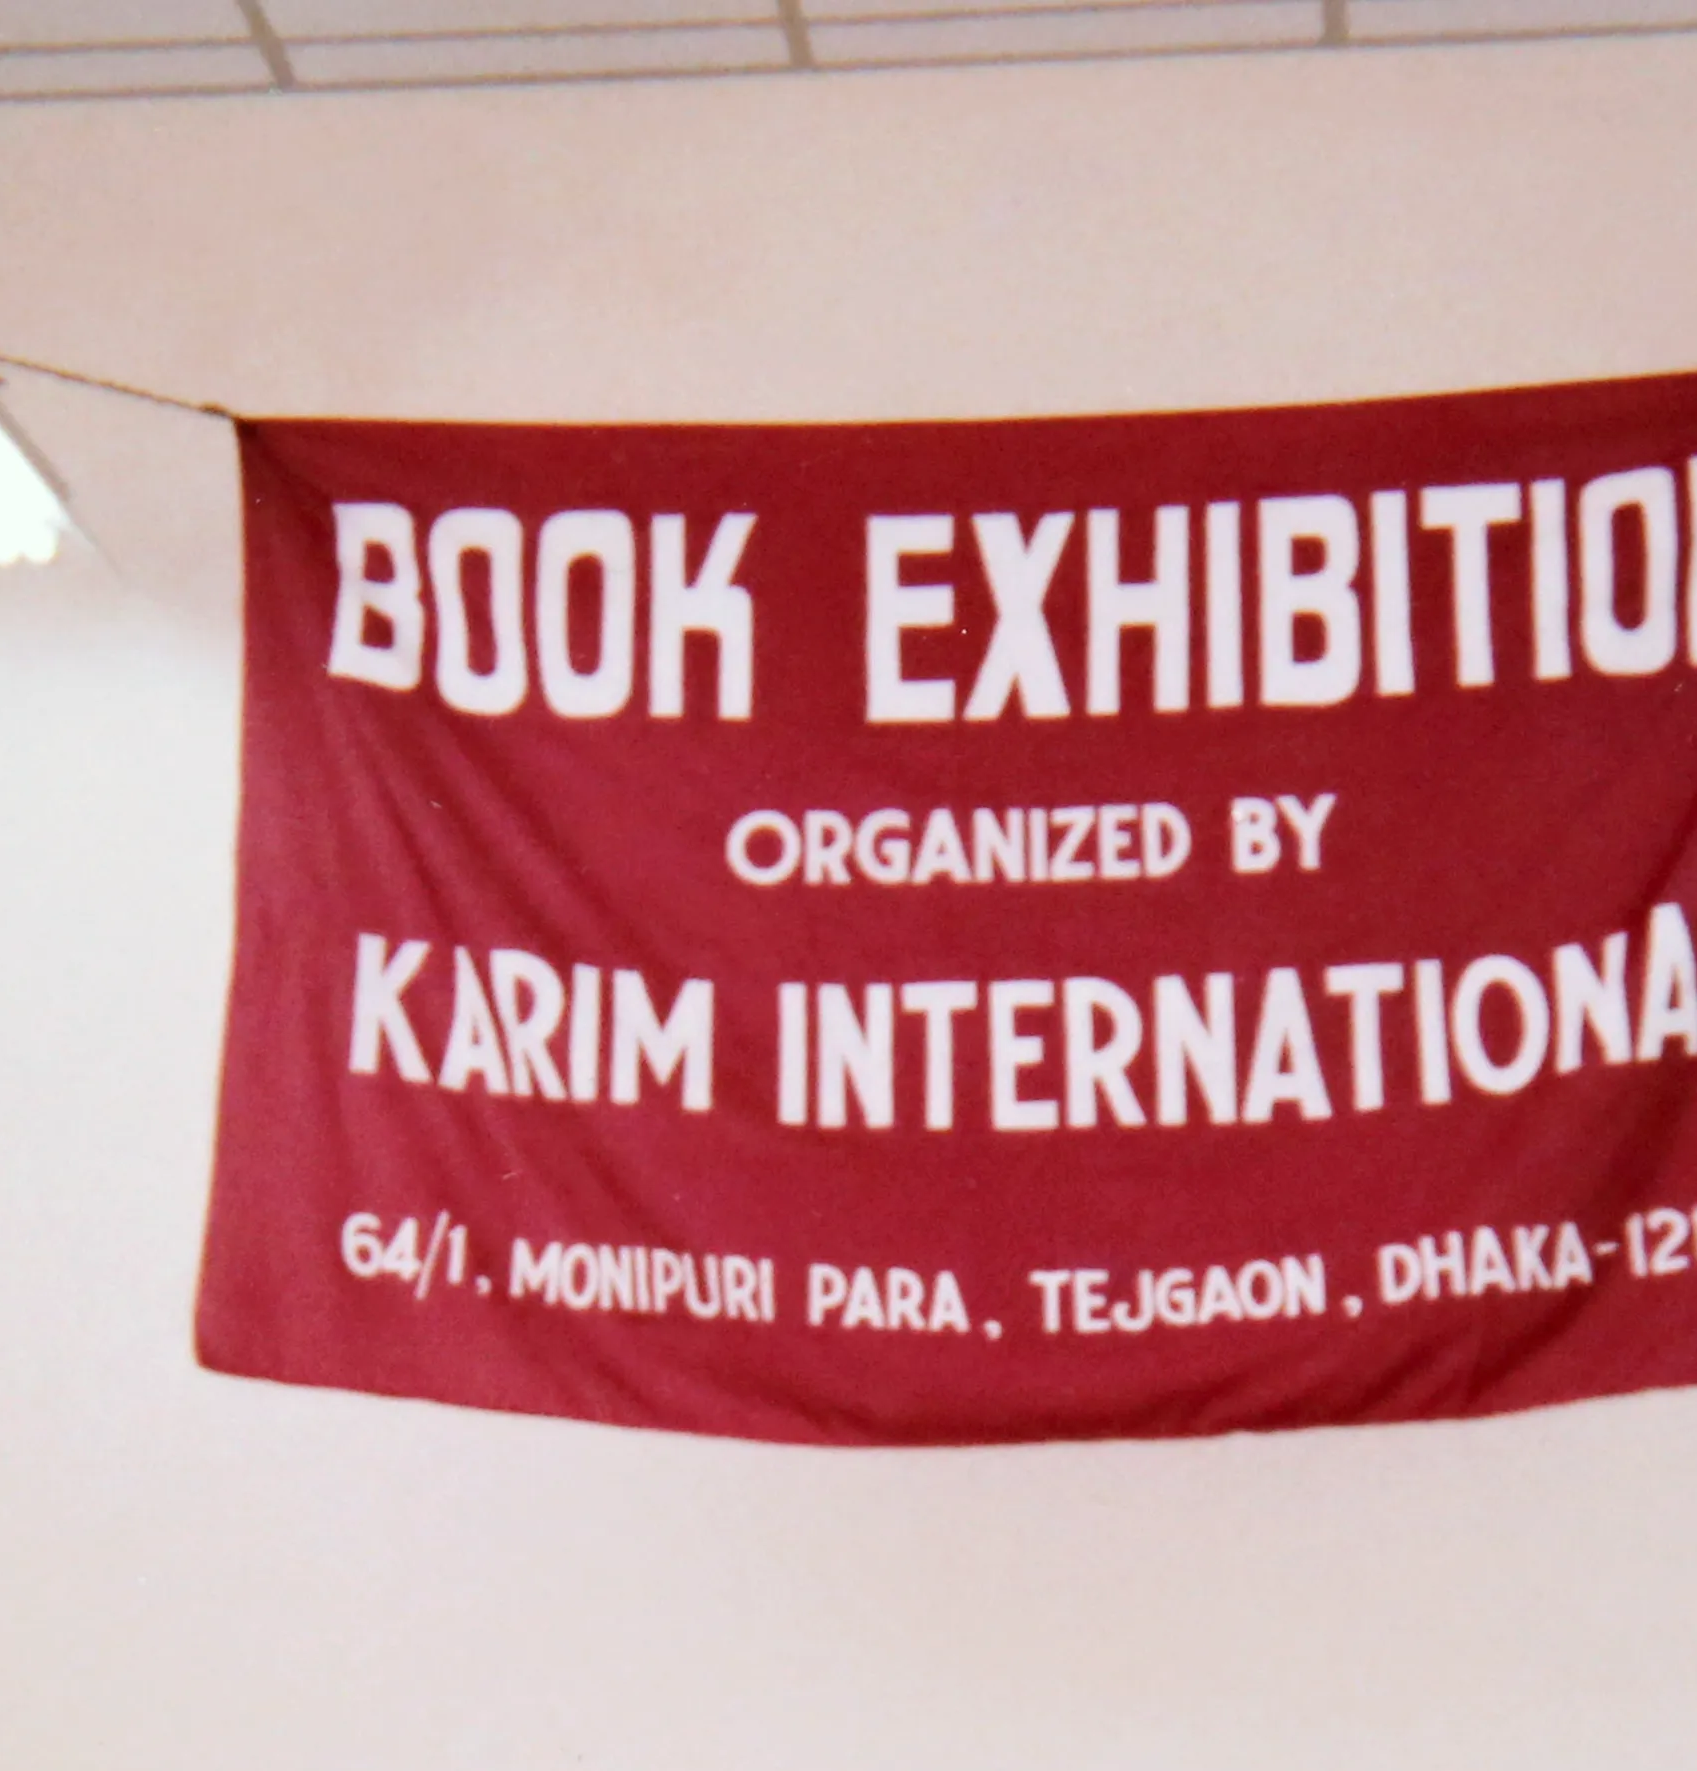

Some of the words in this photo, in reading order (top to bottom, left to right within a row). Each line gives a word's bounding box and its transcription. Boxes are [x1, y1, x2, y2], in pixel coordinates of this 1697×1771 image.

[325, 502, 756, 724] BOOK
[725, 807, 1191, 888] ORGANIZED
[1231, 793, 1336, 874] BY
[348, 932, 715, 1113] KARIM
[341, 1210, 492, 1300] 64/1,
[509, 1237, 776, 1323] MONIPURI
